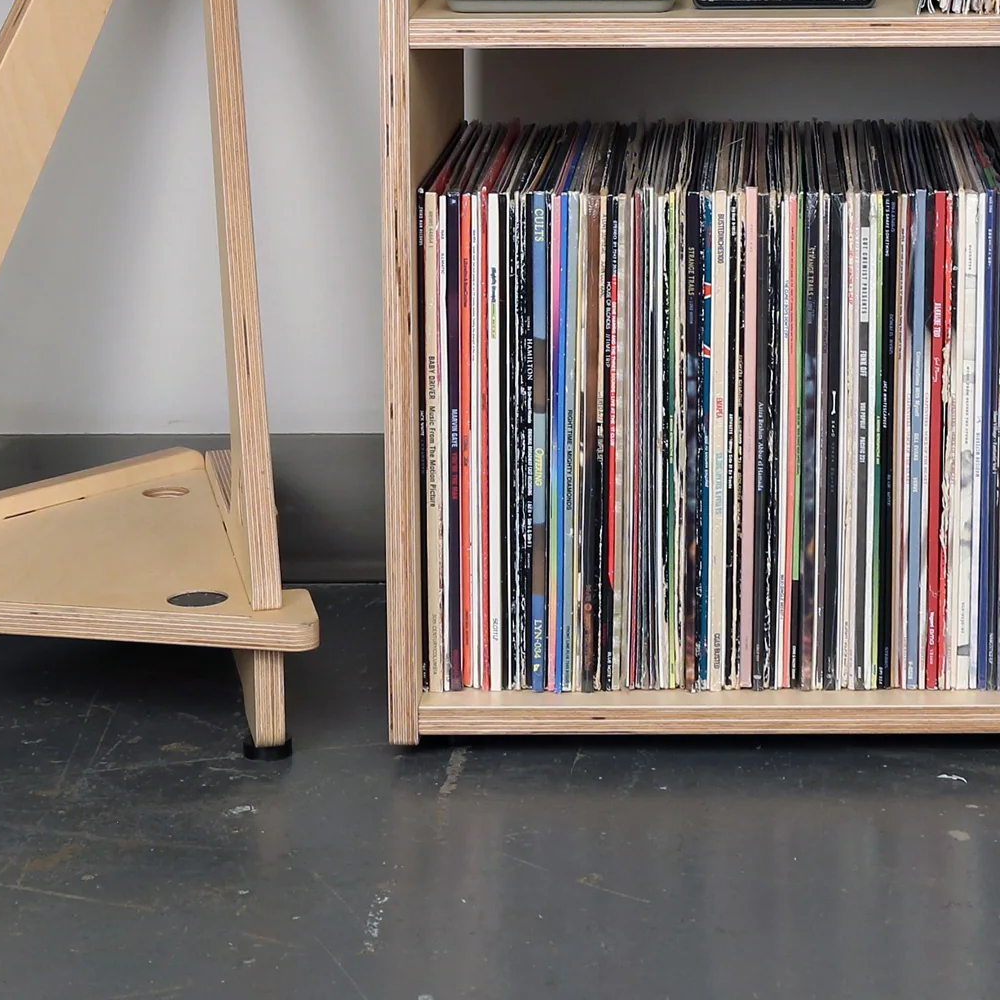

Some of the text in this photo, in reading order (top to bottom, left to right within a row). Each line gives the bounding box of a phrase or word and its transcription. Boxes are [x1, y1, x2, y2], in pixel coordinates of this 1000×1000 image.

[534, 208, 544, 242] CULTS
[535, 448, 544, 486] OFFERING
[534, 619, 542, 658] LYN-034
